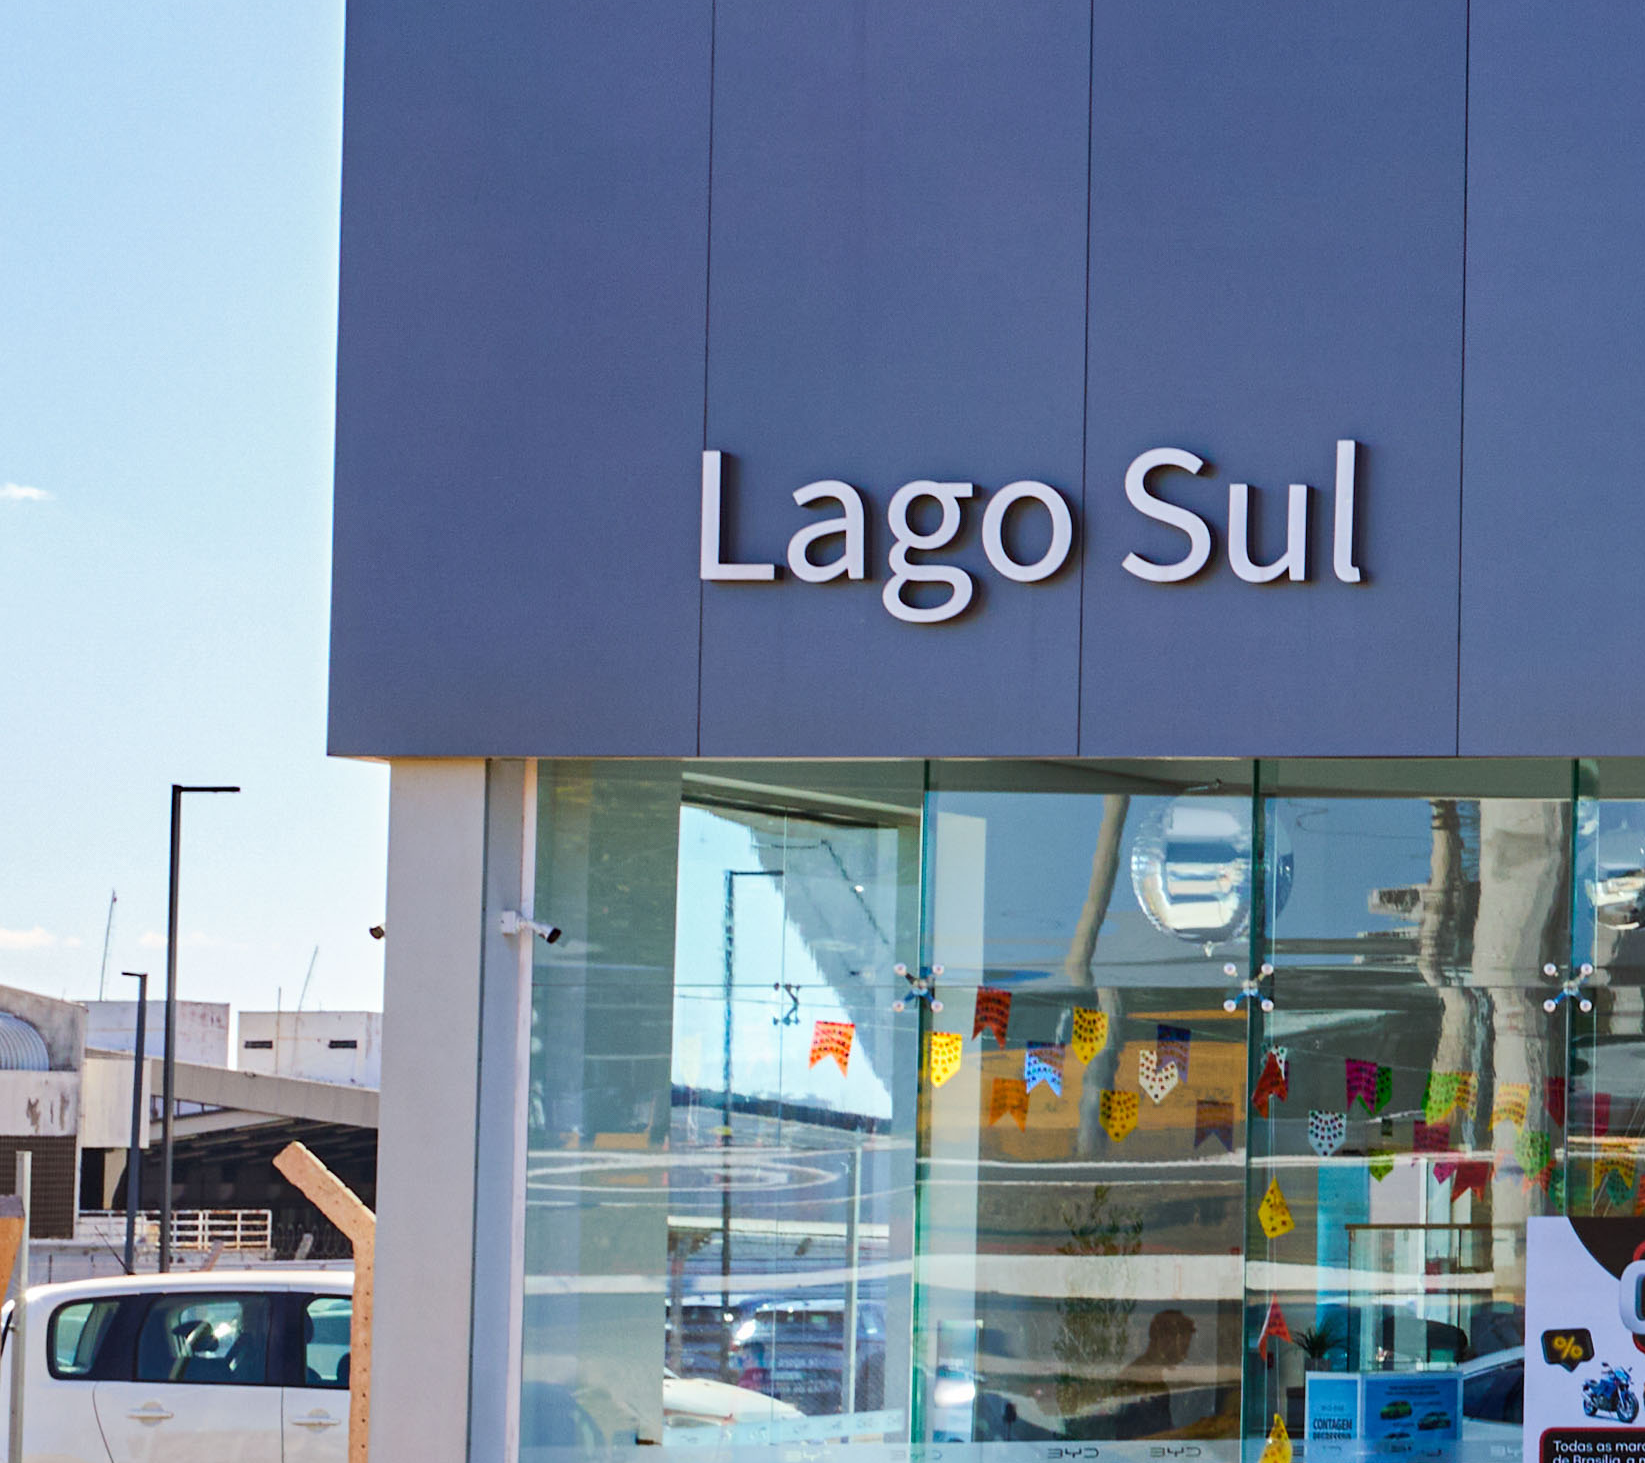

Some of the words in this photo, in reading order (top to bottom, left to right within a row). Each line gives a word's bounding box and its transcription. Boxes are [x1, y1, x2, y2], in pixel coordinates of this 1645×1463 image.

[701, 449, 1072, 623] Lago
[1122, 439, 1361, 583] Sul
[1150, 1446, 1201, 1458] BYD
[1553, 1440, 1593, 1452] Todas
[1596, 1442, 1612, 1452] as
[1048, 1447, 1099, 1460] BYD
